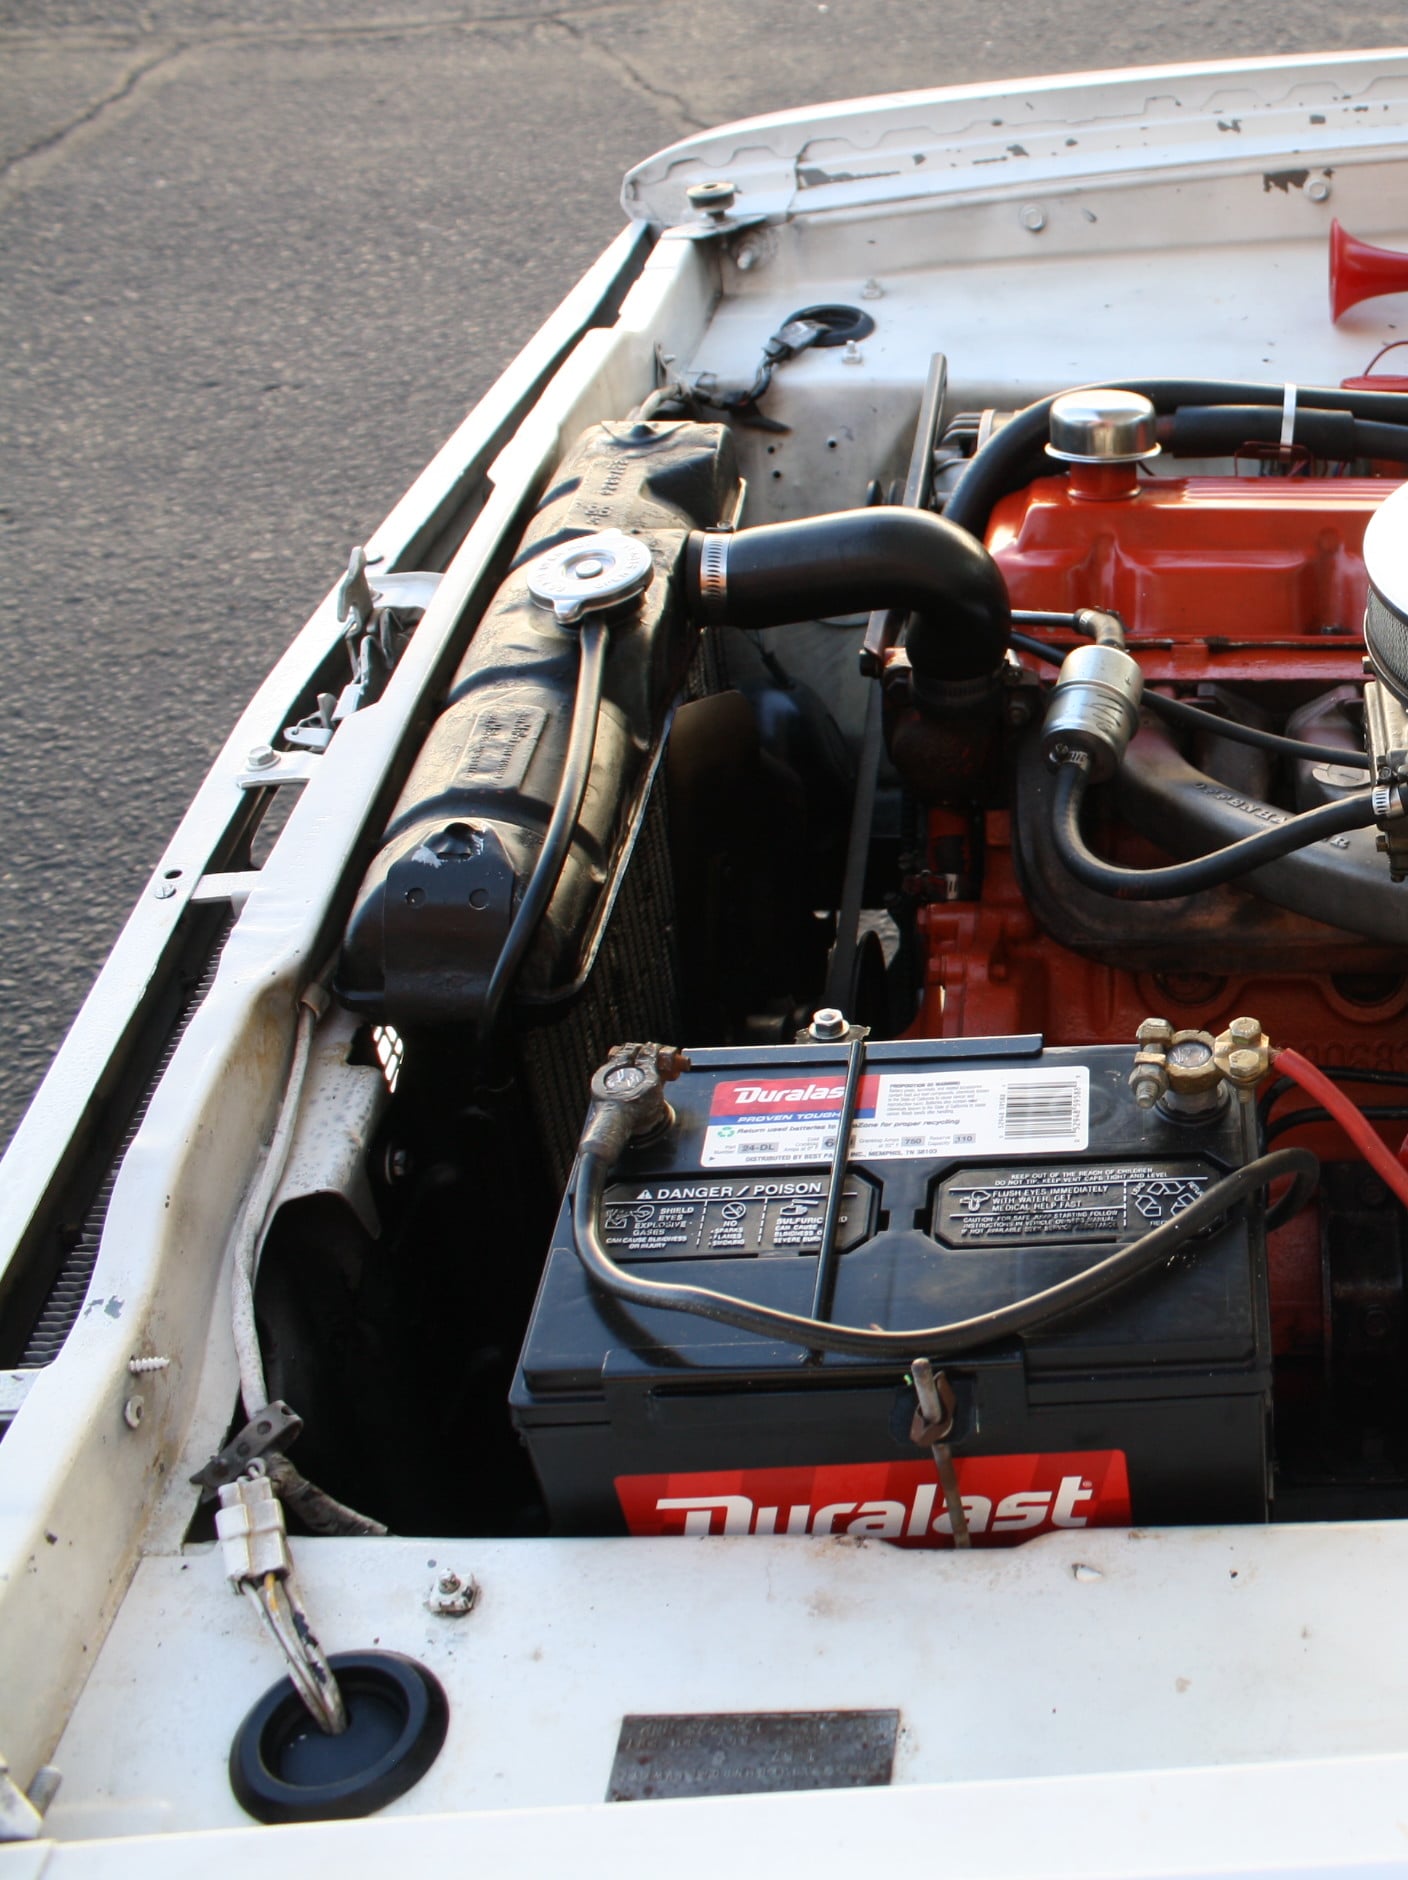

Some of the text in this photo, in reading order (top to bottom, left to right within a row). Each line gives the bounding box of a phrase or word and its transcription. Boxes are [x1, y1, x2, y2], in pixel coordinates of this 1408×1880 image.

[733, 1084, 846, 1104] Duralas
[737, 1111, 842, 1123] PROVEN TOUGH
[737, 1125, 766, 1134] Return
[767, 1125, 788, 1133] used
[789, 1124, 826, 1132] batteries
[827, 1123, 837, 1131] to
[893, 1121, 922, 1129] proper
[923, 1119, 961, 1127] recycling
[741, 1143, 775, 1151] 24-DL
[1078, 1169, 1103, 1177] REACH
[1116, 1167, 1153, 1175] CHILDREN
[1105, 1173, 1127, 1181] TIGHT
[1146, 1171, 1168, 1179] LEVEL
[656, 1187, 733, 1200] DANGER
[753, 1182, 822, 1196] POISON
[992, 1185, 1109, 1198] FLUSH EYES IMMEDIATELY
[992, 1197, 1016, 1205] WITH
[1053, 1194, 1072, 1202] GET
[660, 1206, 695, 1215] SHIELD
[991, 1200, 1082, 1212] MEDICAL HELP FAST
[657, 1214, 684, 1222] EYES
[996, 1214, 1012, 1222] FOR
[1053, 1211, 1088, 1219] STARTING
[1088, 1209, 1119, 1217] FOLLOW
[634, 1220, 687, 1229] EXPLOSIVE
[776, 1216, 824, 1225] SULFURIC
[962, 1221, 1014, 1229] INSTRUCTIONS
[632, 1228, 666, 1237] GASES
[969, 1227, 984, 1235] NOT
[622, 1236, 647, 1244] CAUSE
[647, 1235, 688, 1243] BLINDNESS
[712, 1239, 746, 1247] SMOKING
[773, 1236, 801, 1244] SEVERE
